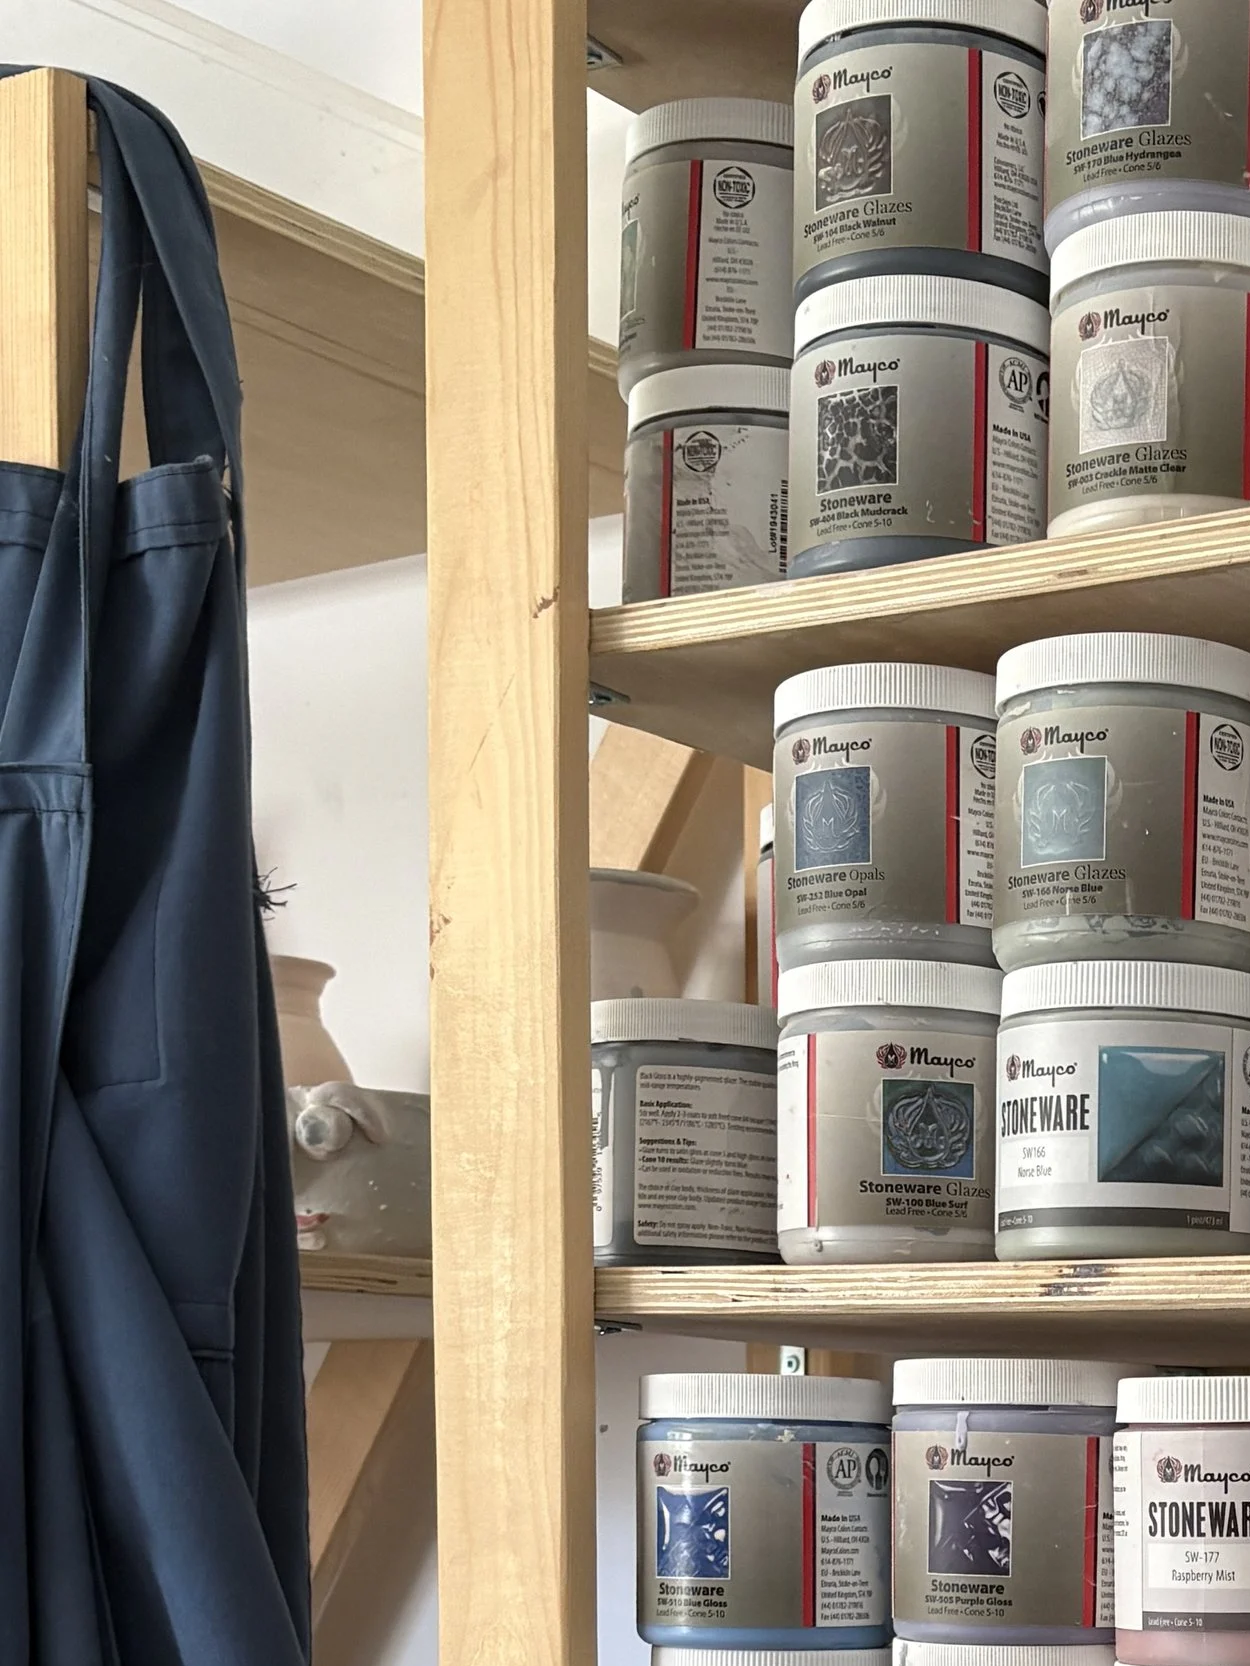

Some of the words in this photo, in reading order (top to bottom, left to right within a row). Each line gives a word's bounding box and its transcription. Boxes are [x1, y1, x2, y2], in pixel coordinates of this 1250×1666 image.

[832, 67, 890, 93] Mayco
[1066, 136, 1133, 165] Stoneware
[1139, 131, 1192, 147] Glazes
[803, 207, 860, 239] Stoneware
[862, 199, 913, 216] Glazes
[1104, 309, 1168, 334] Mayco
[837, 357, 898, 384] Mayco
[1066, 452, 1130, 477] Stoneware
[1135, 446, 1187, 461] Glazes
[819, 491, 892, 512] Stoneware
[812, 736, 871, 762] Mayco
[1043, 726, 1108, 754] Mayco
[787, 870, 847, 890] Stoneware
[849, 869, 885, 882] Opals
[1007, 867, 1070, 890] Stoneware
[1074, 864, 1126, 880] Glazes
[909, 1046, 974, 1077] Mayco
[1022, 1059, 1077, 1088] Mayco
[1002, 1094, 1090, 1137] STONEWARE
[1017, 1167, 1035, 1178] Norse
[1036, 1165, 1052, 1177] Blue
[859, 1180, 941, 1195] Stoneware
[946, 1181, 991, 1199] Glazes
[885, 1198, 922, 1209] SW-100
[924, 1198, 945, 1209] Blue
[947, 1200, 968, 1210] Surf
[673, 1456, 730, 1482] Mayco
[835, 1460, 856, 1478] AP
[951, 1449, 1014, 1477] Mayco
[1185, 1551, 1219, 1563] SW-177
[659, 1582, 725, 1597] Stoneware
[931, 1579, 1005, 1595] Stoneware
[1172, 1570, 1213, 1584] Raspberry
[1216, 1571, 1235, 1582] Mist
